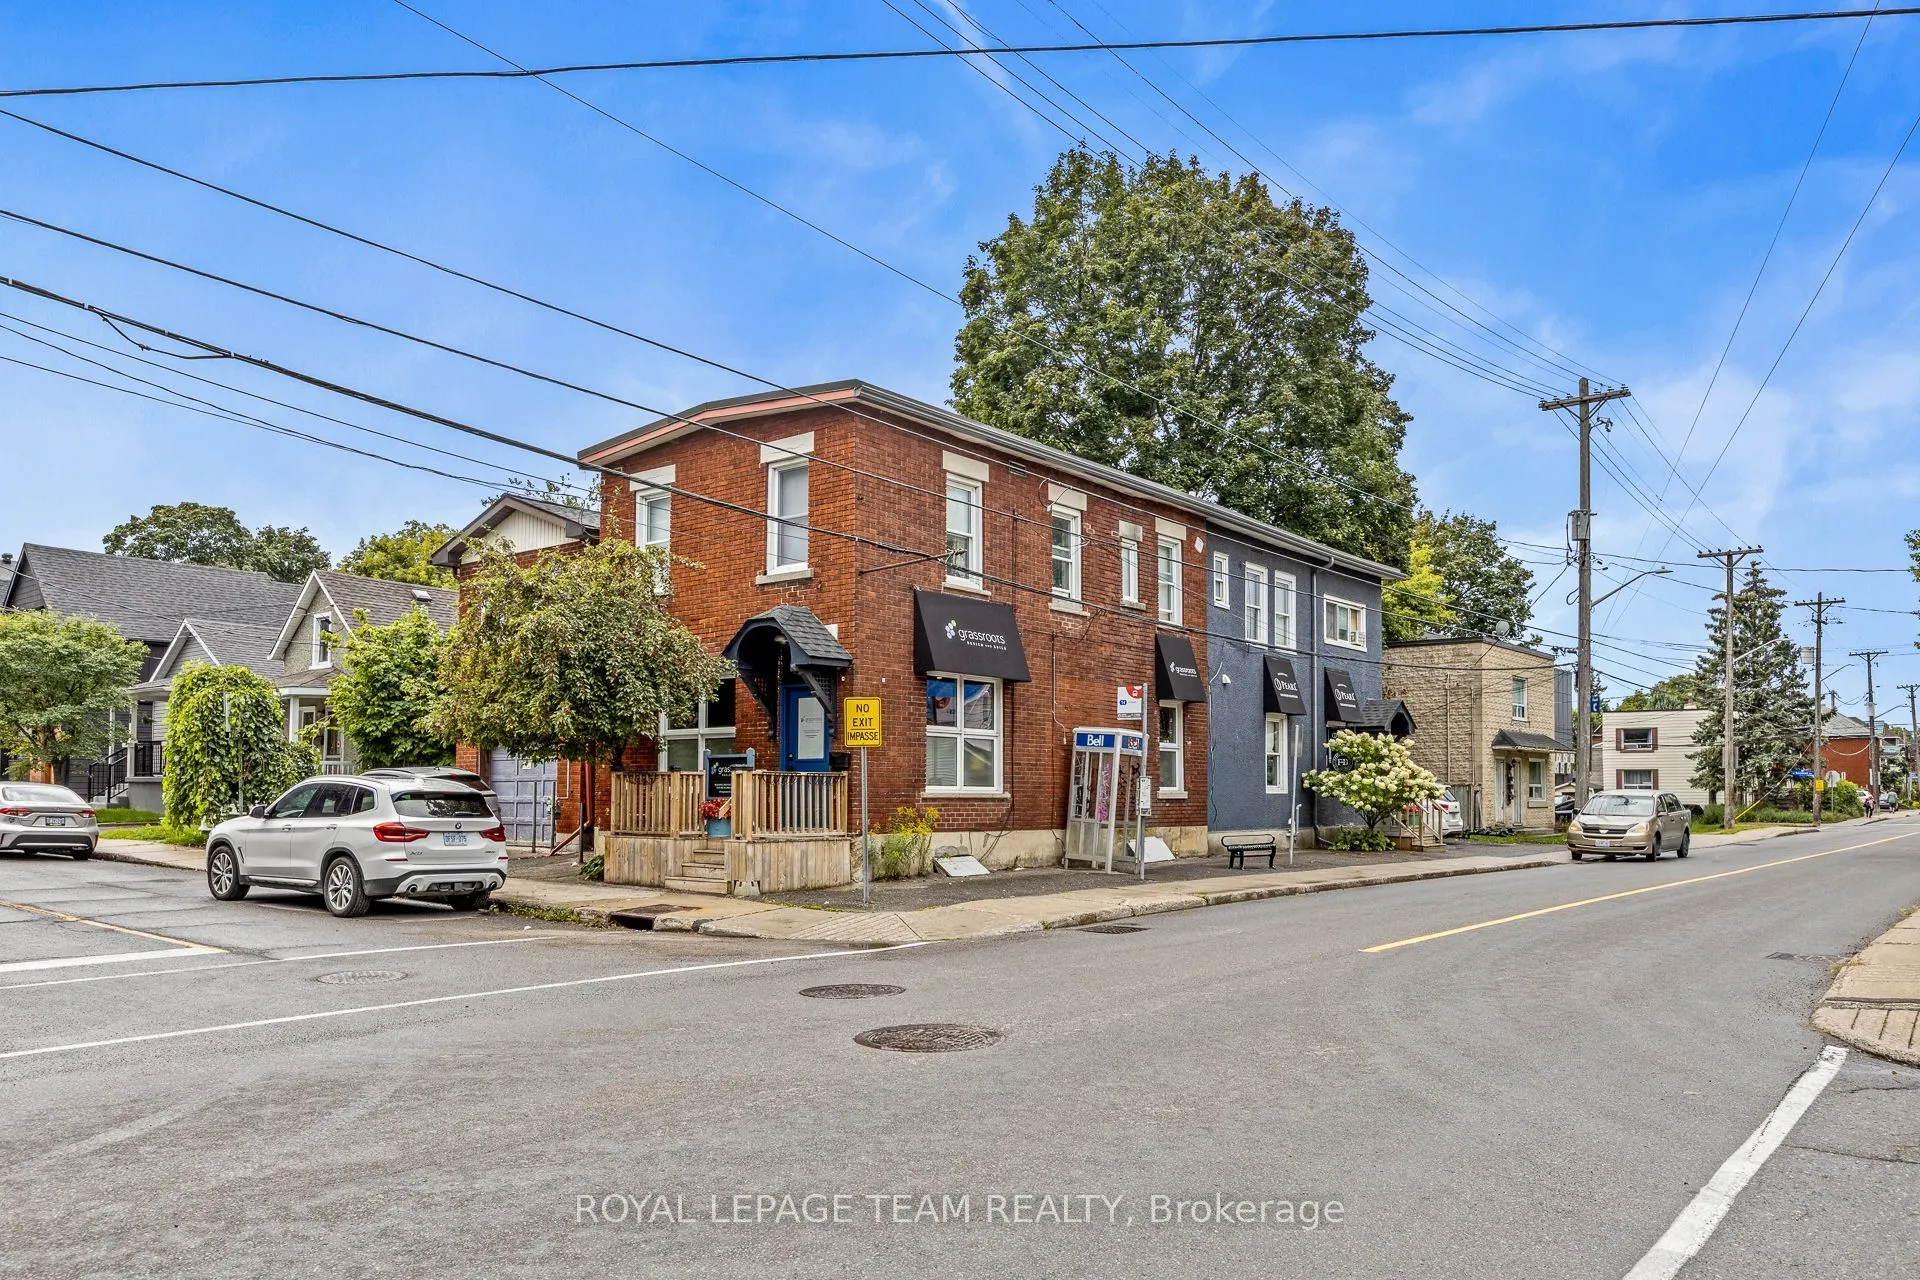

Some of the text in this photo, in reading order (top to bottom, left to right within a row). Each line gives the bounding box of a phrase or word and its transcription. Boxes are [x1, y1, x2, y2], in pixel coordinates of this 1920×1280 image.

[958, 629, 1006, 645] grassroots
[856, 703, 870, 713] NO
[852, 717, 873, 727] EXIT
[847, 731, 879, 741] IMPASSE
[1087, 734, 1104, 747] Bell
